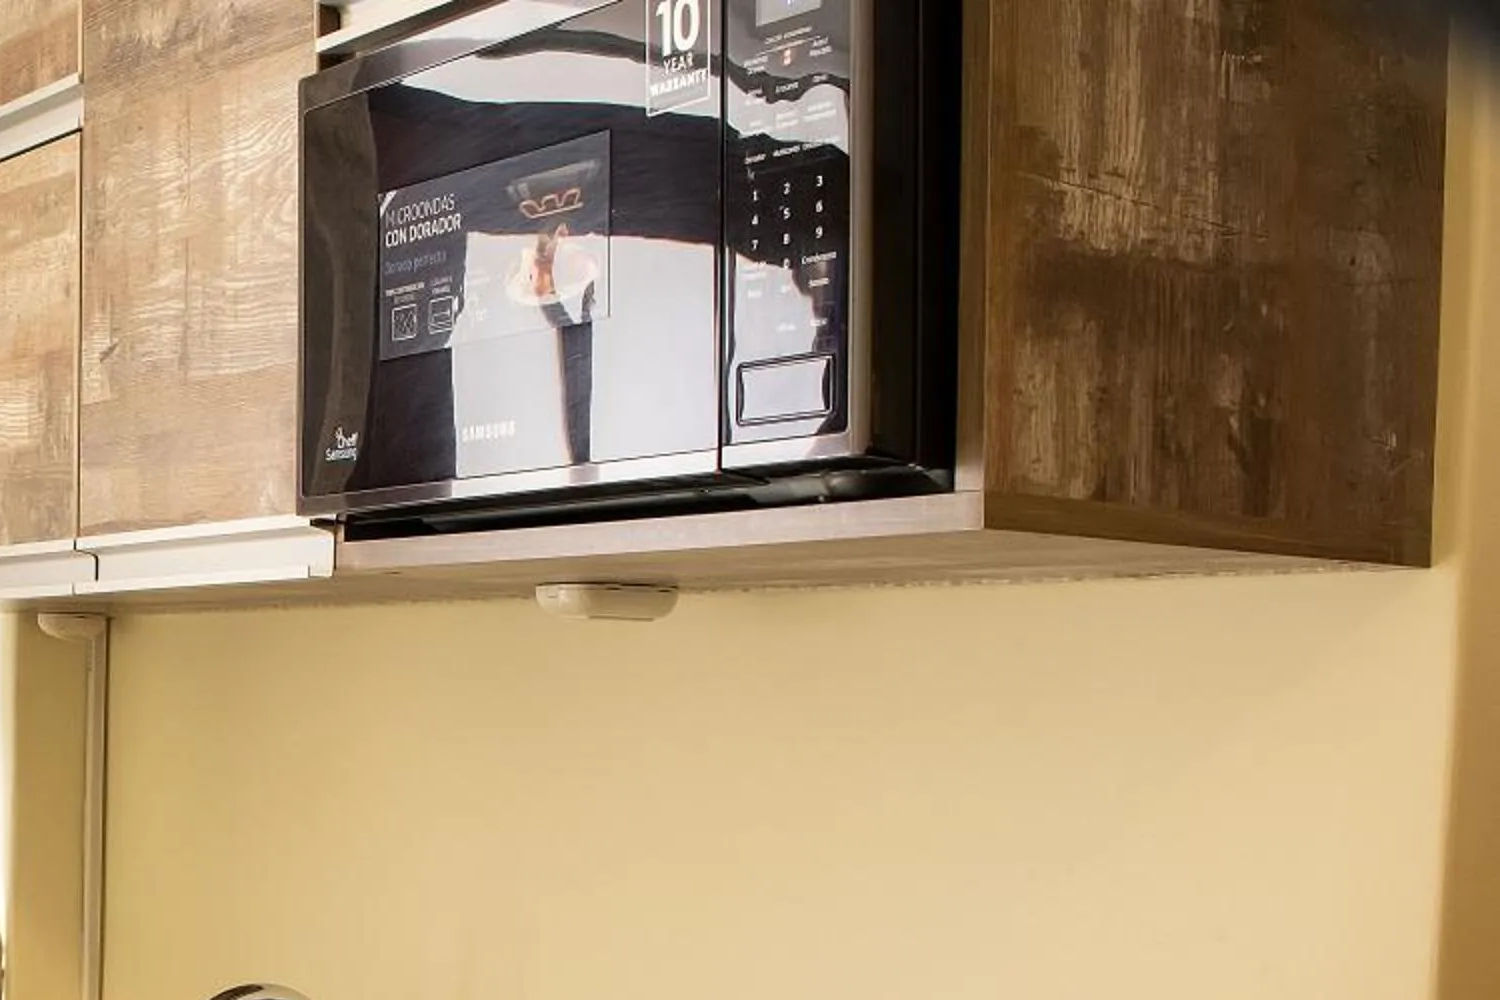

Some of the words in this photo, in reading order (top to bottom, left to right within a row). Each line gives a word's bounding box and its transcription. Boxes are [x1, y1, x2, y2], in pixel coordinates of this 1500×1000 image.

[655, 0, 700, 57] 10
[663, 52, 693, 74] YEAR
[783, 182, 790, 195] 2
[816, 175, 823, 188] 3
[385, 193, 455, 229] MCROONDAS
[783, 207, 791, 220] 5
[815, 200, 823, 213] 6
[385, 227, 407, 248] CON
[409, 213, 461, 243] DORADOR
[751, 239, 759, 251] 7
[815, 226, 823, 239] 9
